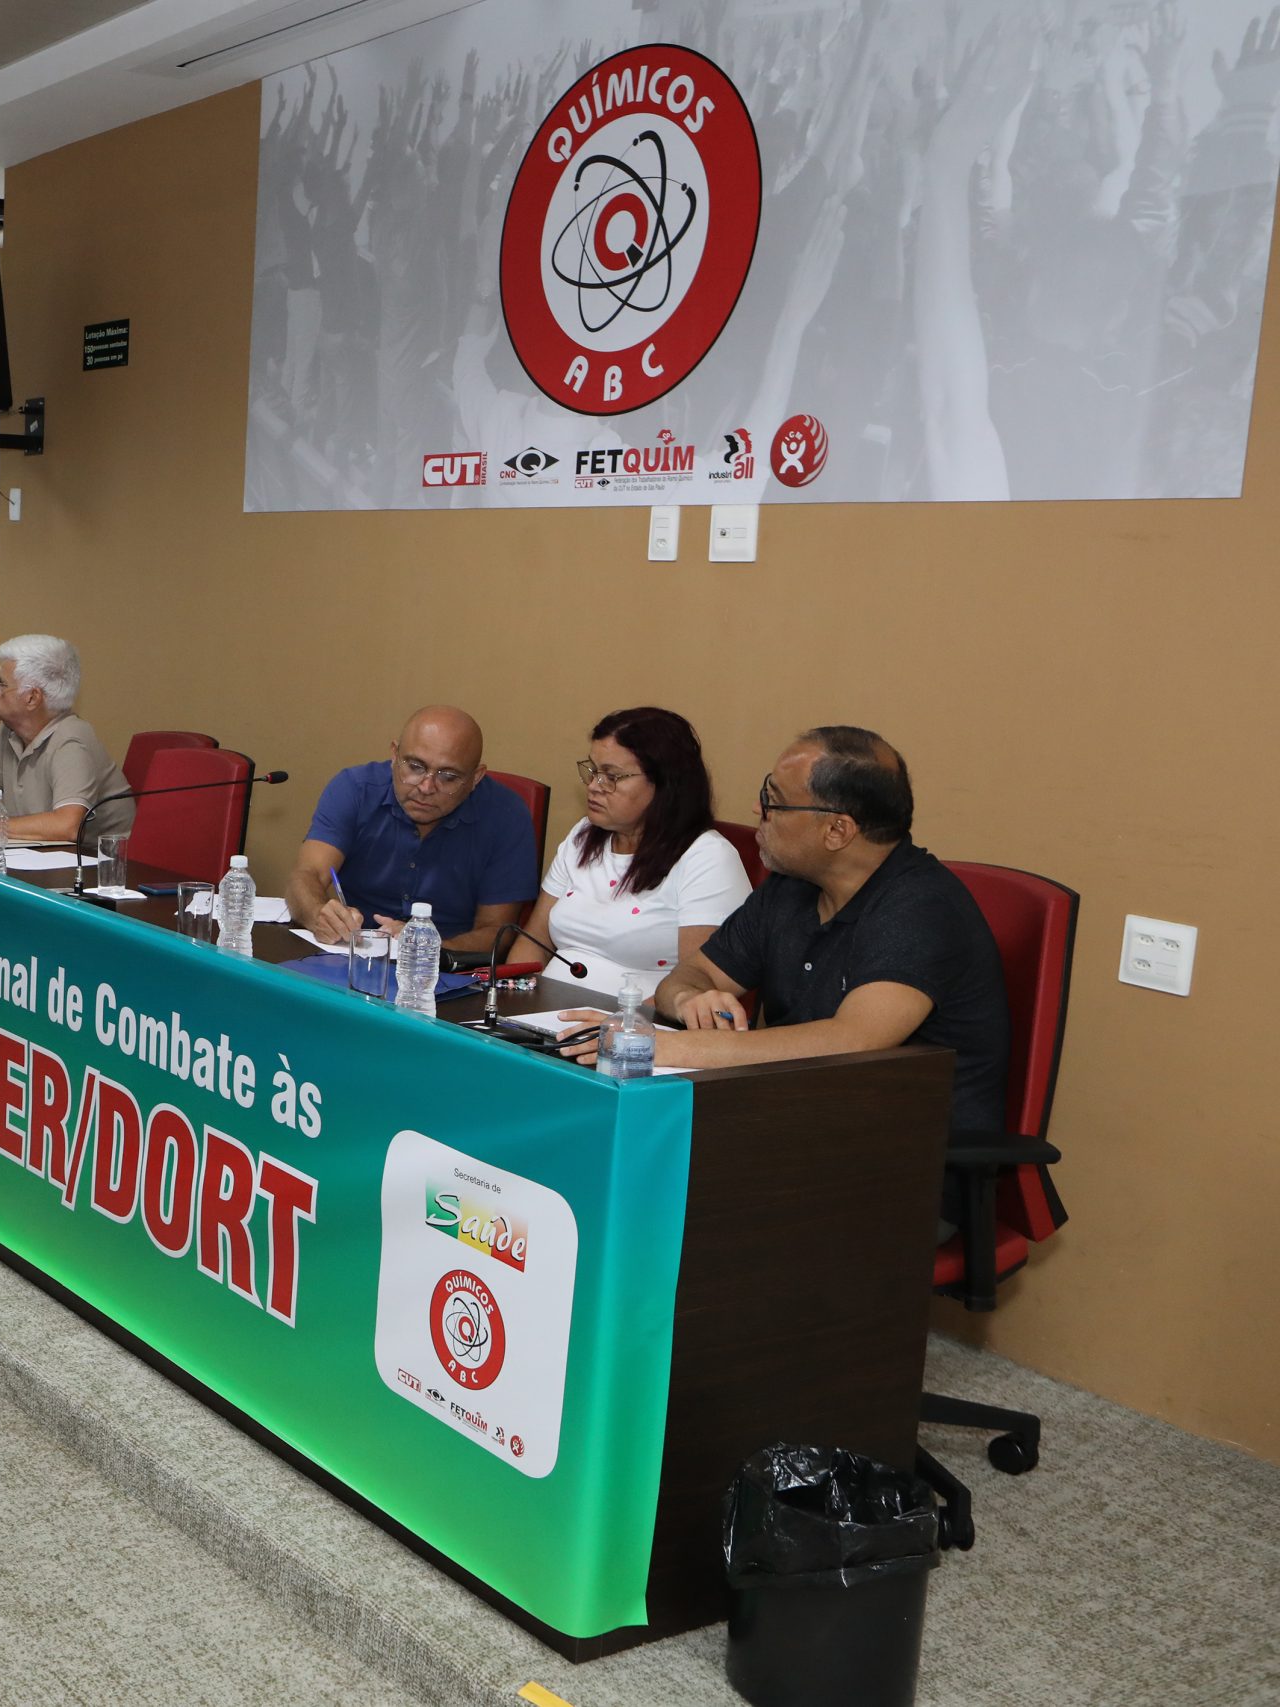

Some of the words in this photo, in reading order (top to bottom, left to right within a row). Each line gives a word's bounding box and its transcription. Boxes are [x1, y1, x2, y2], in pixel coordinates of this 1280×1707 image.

[547, 65, 716, 163] QUÍMICOS
[424, 456, 480, 485] CUT
[500, 471, 516, 479] CNQ
[575, 480, 592, 488] CUT
[47, 966, 83, 1032] de
[94, 982, 256, 1109] Combate
[270, 1052, 322, 1139] às
[453, 1167, 490, 1190] Secretaria
[492, 1183, 501, 1194] de
[425, 1191, 526, 1262] Saúde
[445, 1271, 494, 1315] QUÍMICOS
[399, 1370, 420, 1391] CUT
